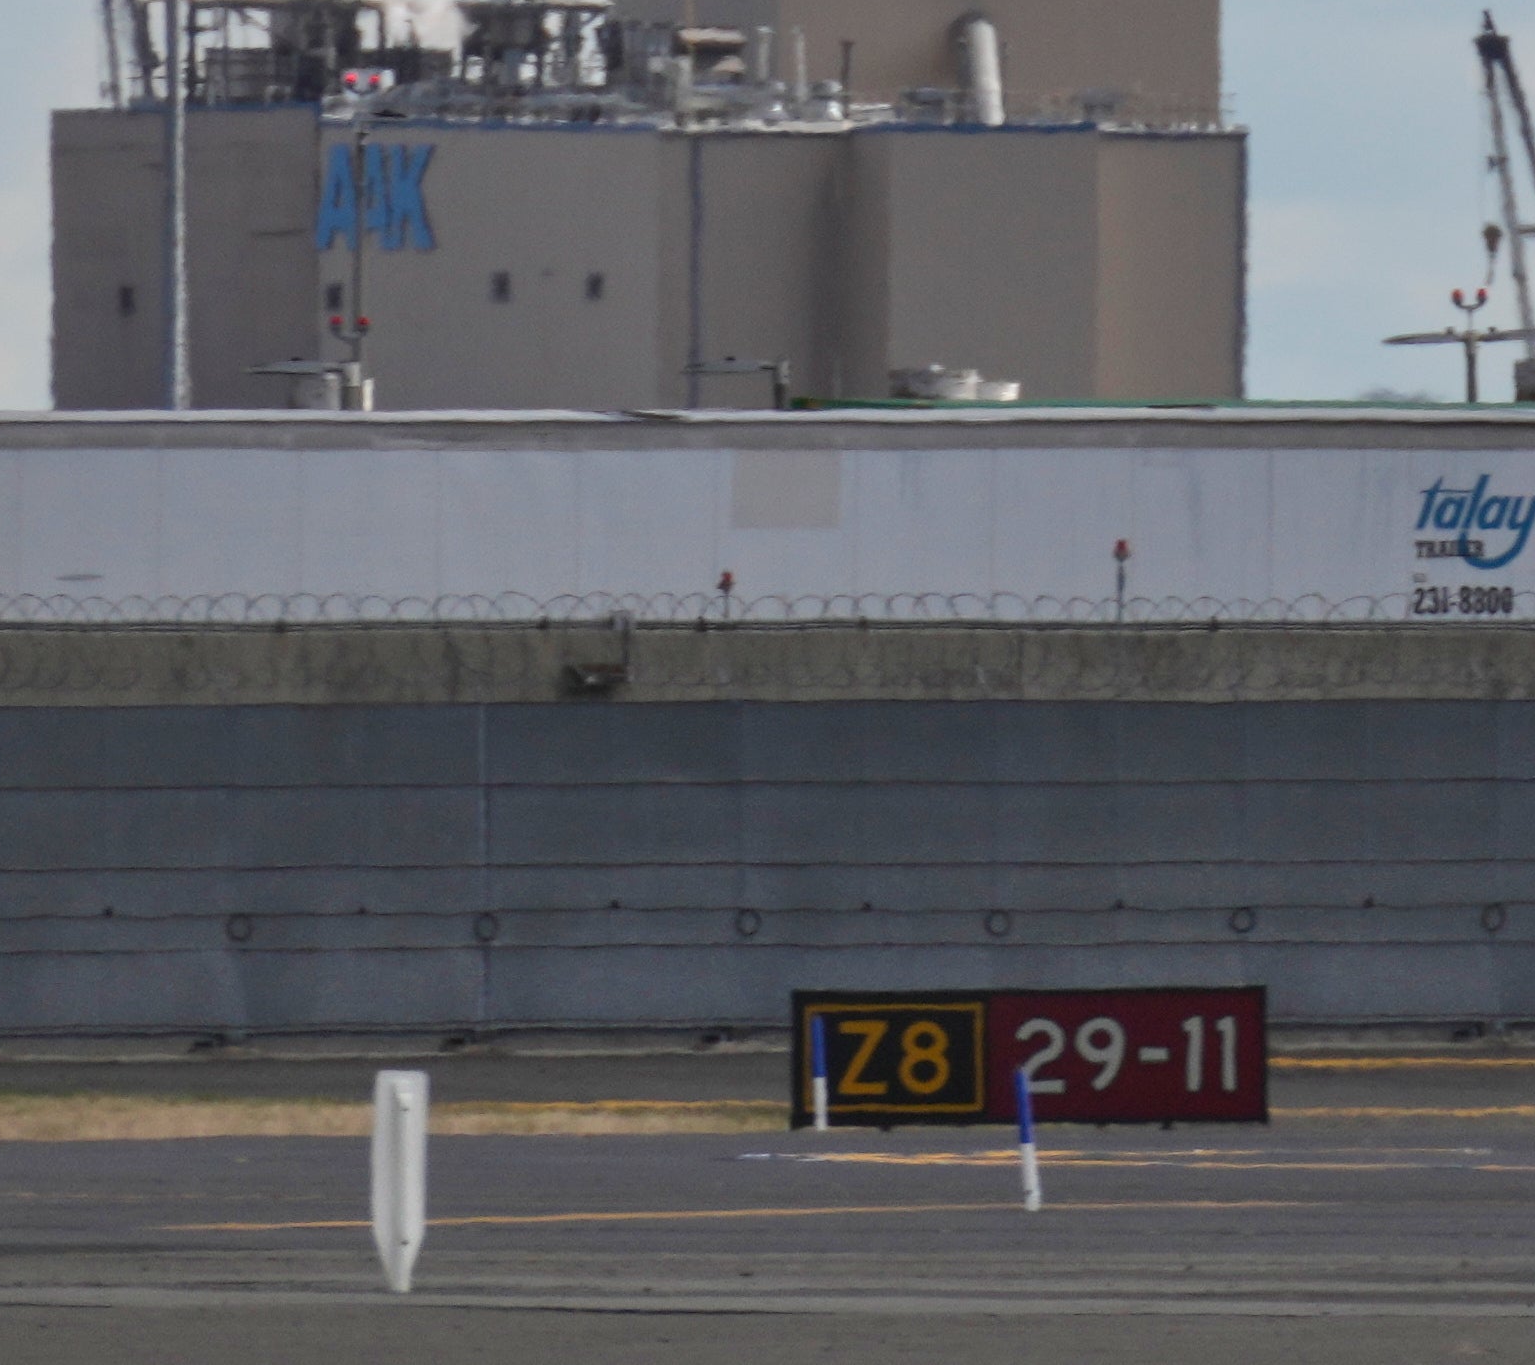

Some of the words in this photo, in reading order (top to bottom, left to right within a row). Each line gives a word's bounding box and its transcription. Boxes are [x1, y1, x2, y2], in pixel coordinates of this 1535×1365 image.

[316, 143, 438, 252] AAK
[837, 1020, 951, 1095] Z8
[1014, 1015, 1237, 1093] 29-11
